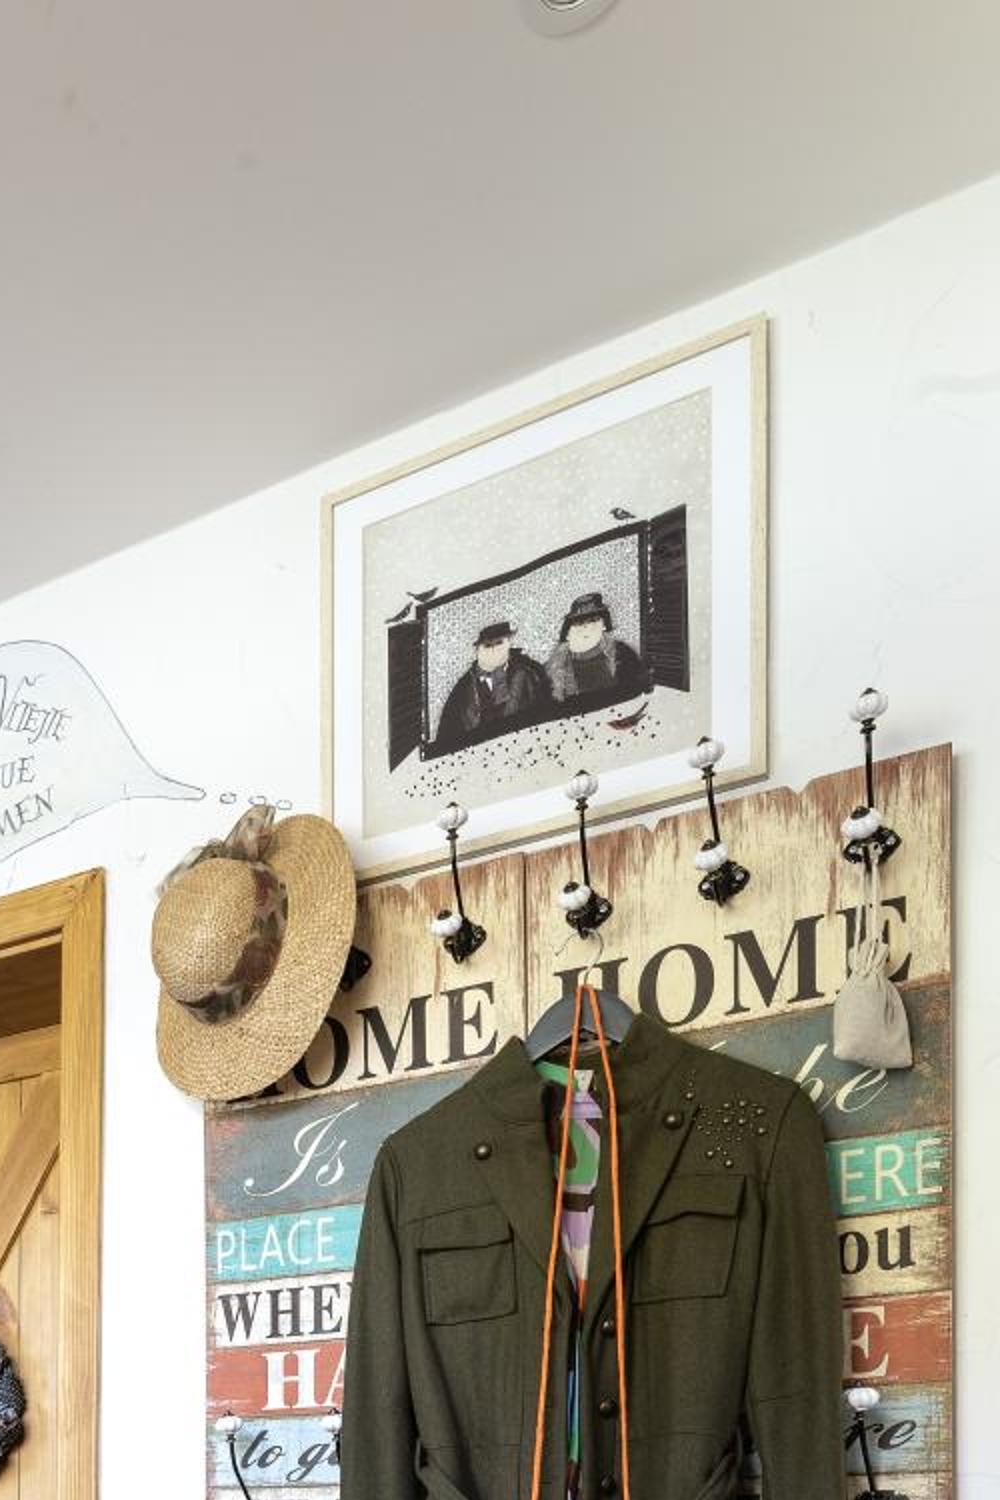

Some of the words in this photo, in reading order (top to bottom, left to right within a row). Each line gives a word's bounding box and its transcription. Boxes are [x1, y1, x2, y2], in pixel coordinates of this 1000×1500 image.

[228, 981, 499, 1104] OME
[216, 1216, 336, 1275] PLACE
[839, 1137, 944, 1204] ERE
[243, 1102, 359, 1198] Is
[217, 1282, 353, 1342] WHE
[839, 1224, 917, 1276] ou
[240, 1429, 287, 1470] to
